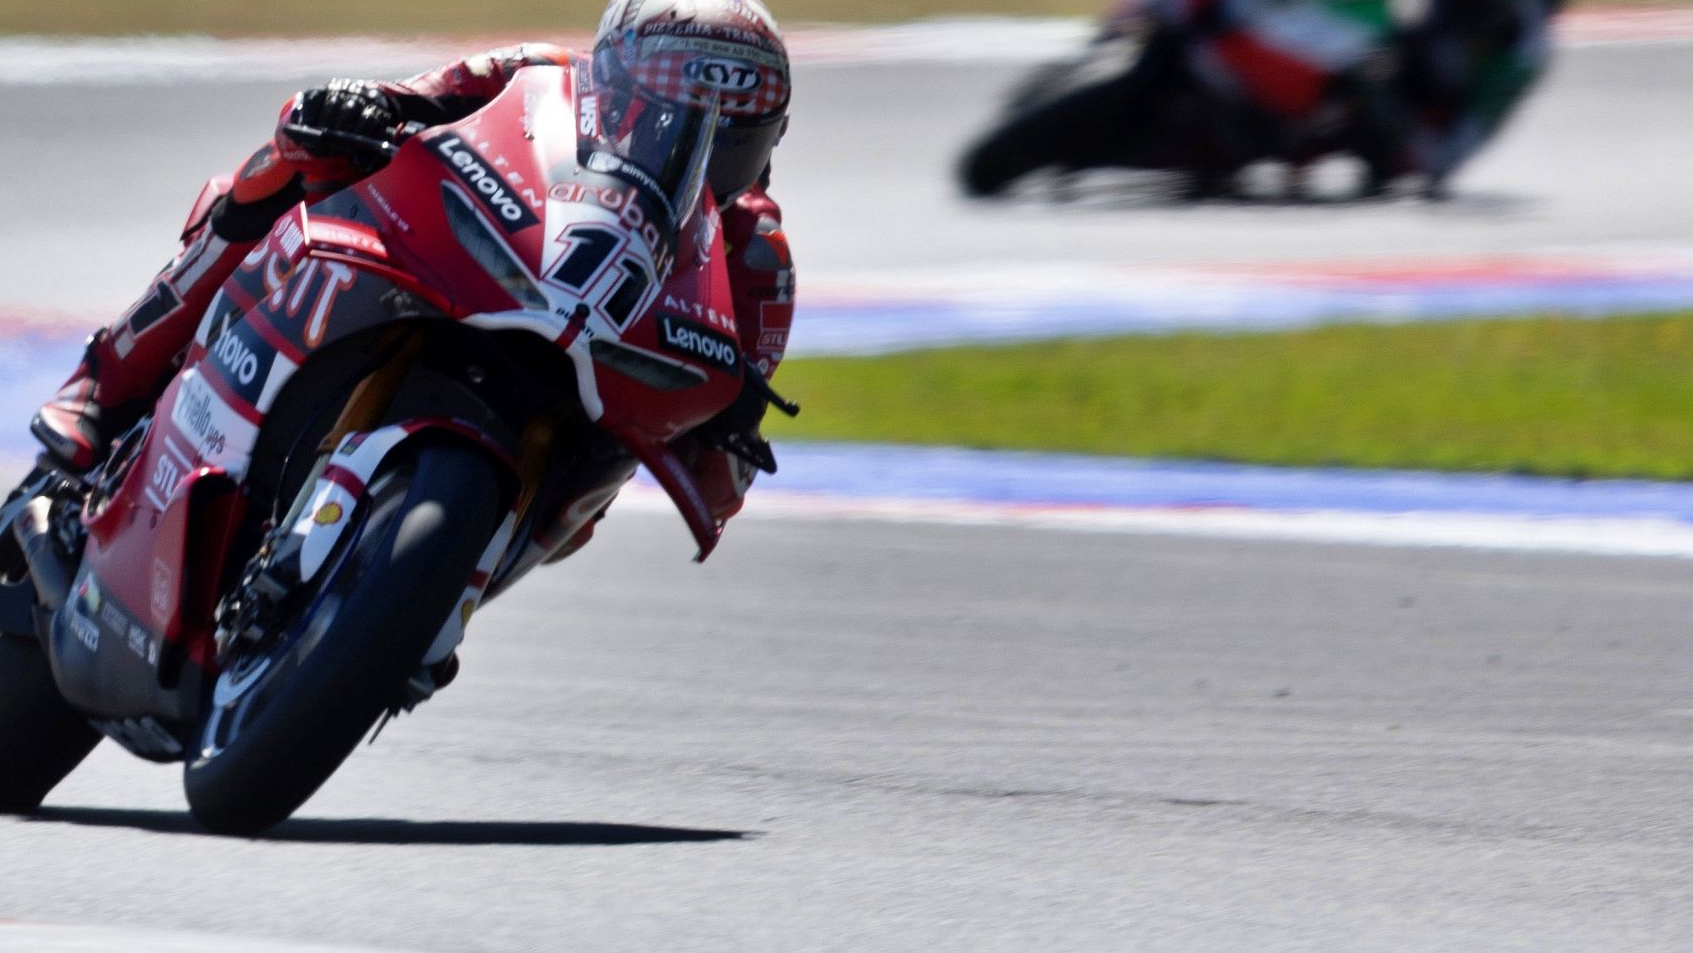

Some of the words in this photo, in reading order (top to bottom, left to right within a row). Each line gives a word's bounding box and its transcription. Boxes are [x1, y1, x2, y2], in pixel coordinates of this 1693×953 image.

[701, 63, 756, 87] KYT
[437, 137, 523, 222] Lenovo
[545, 223, 657, 335] 11
[663, 294, 737, 334] ALTEN
[663, 317, 737, 366] Lenovo
